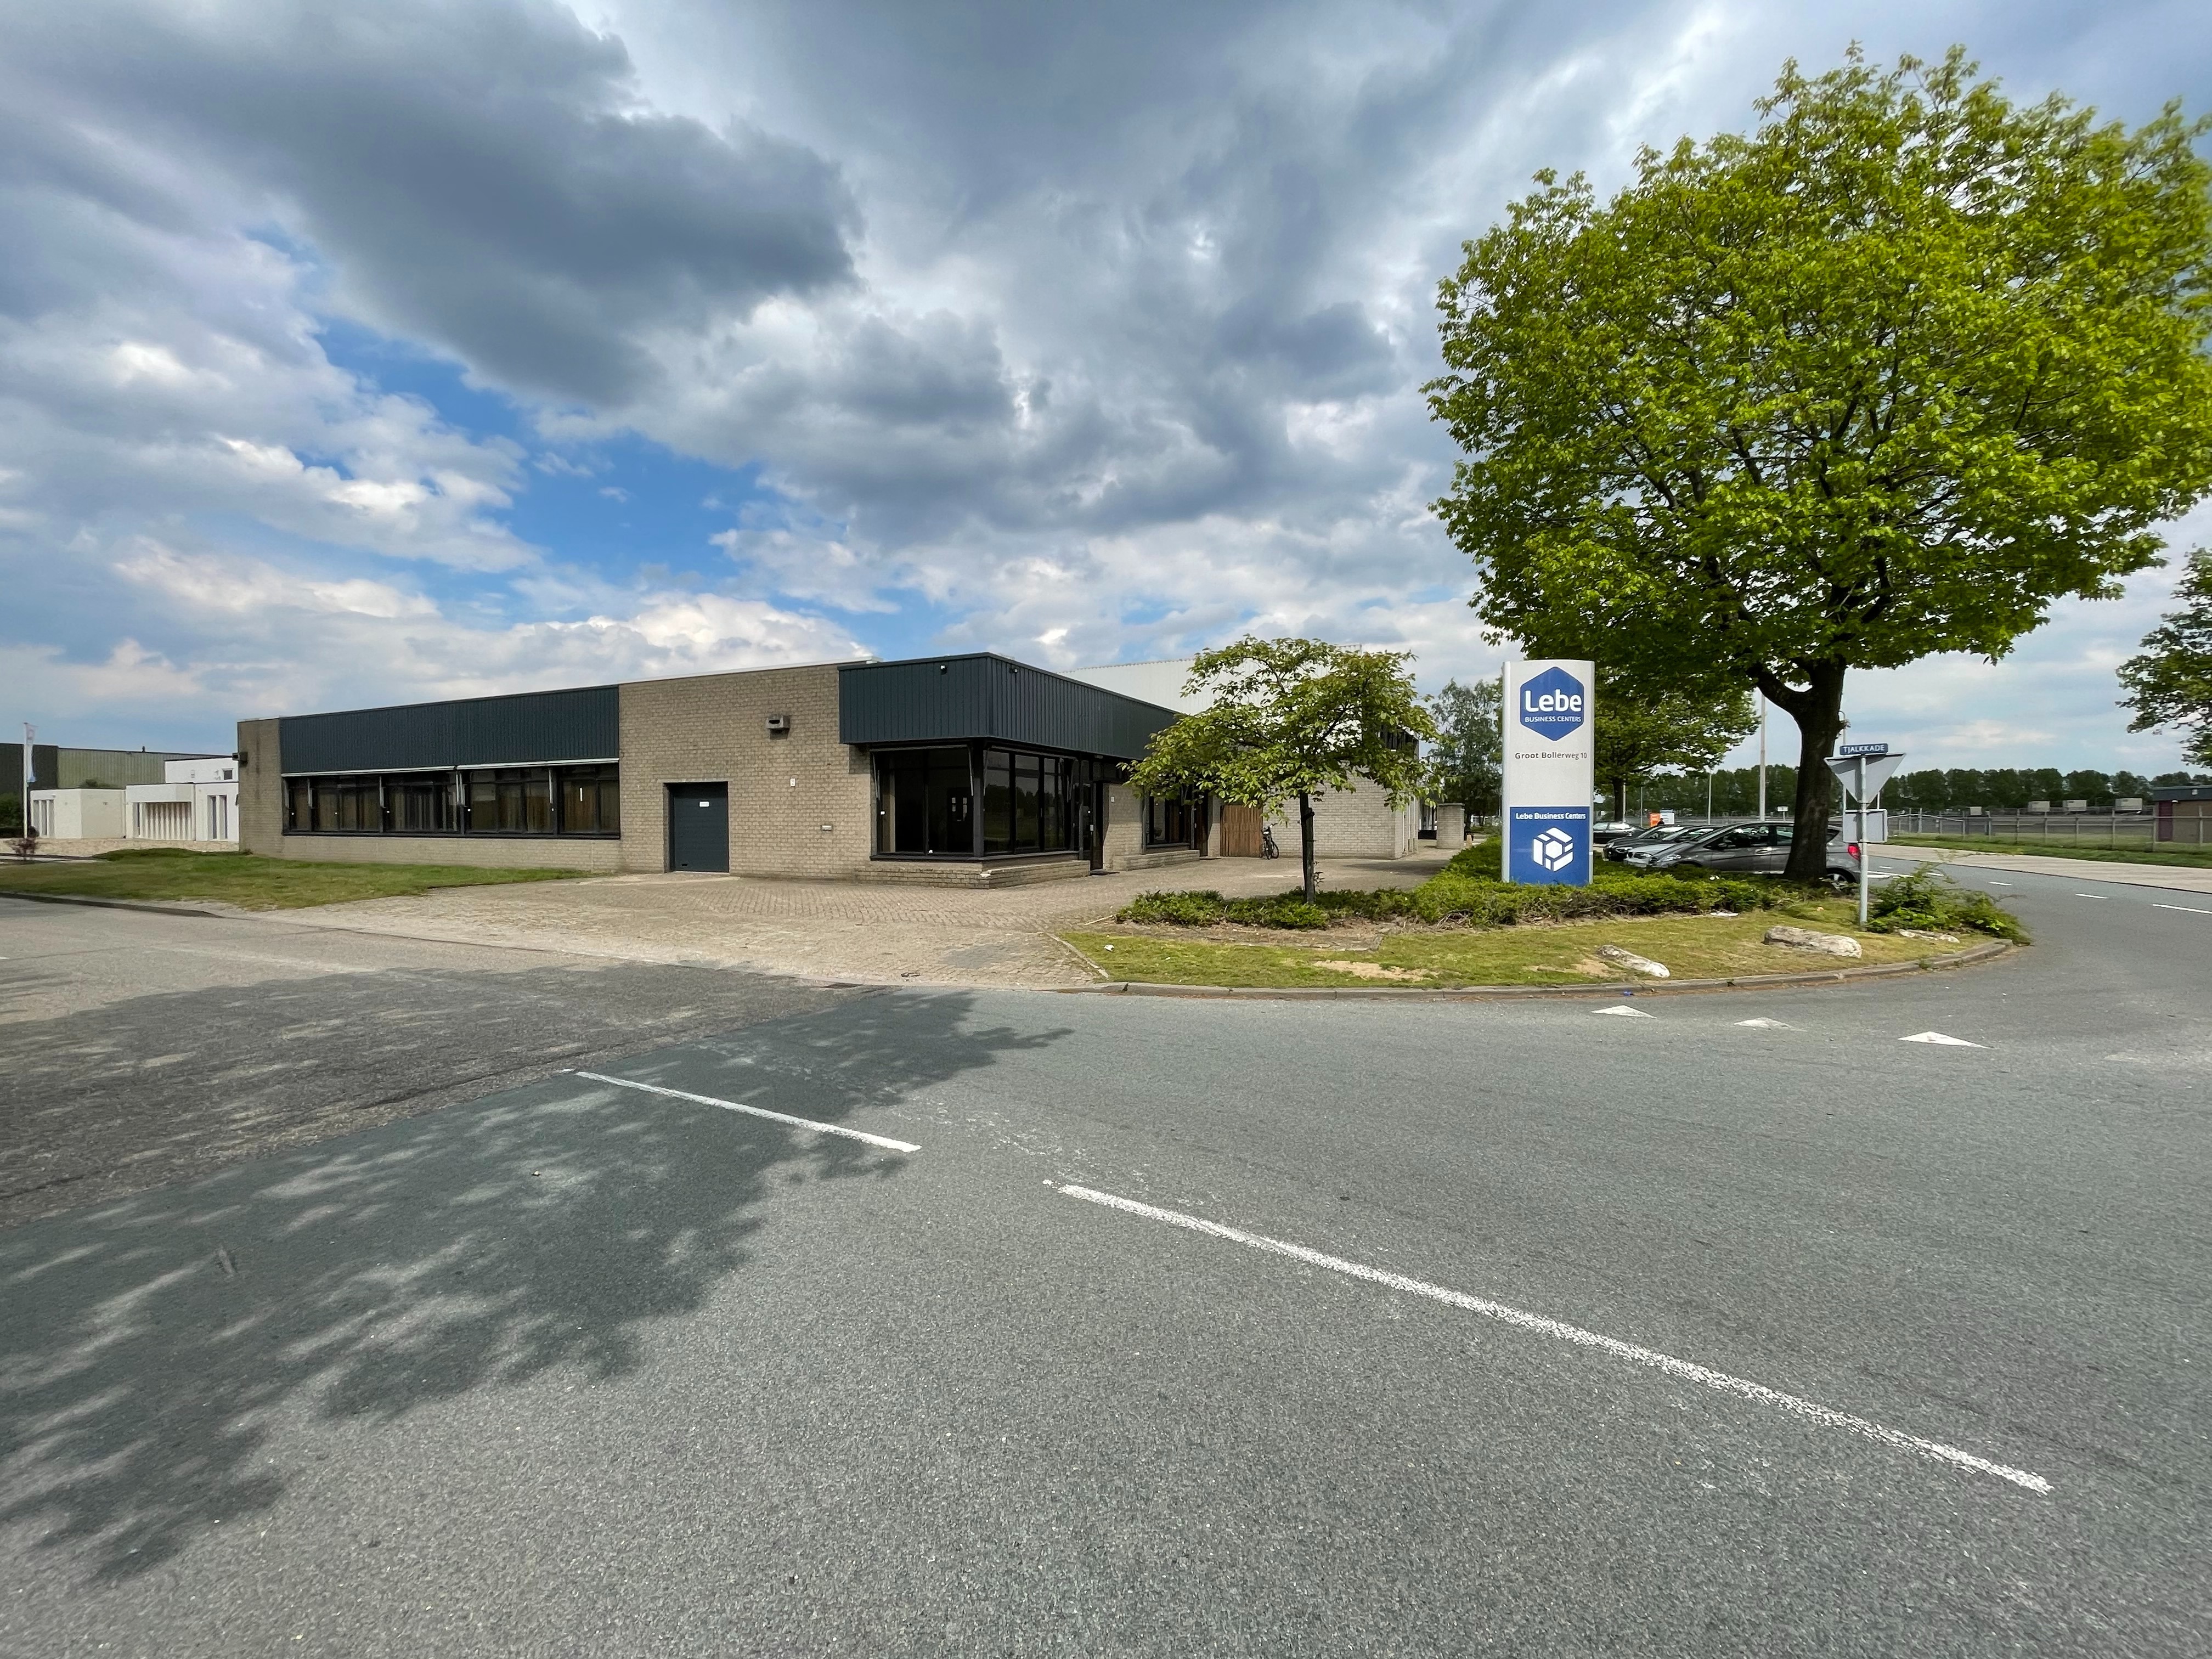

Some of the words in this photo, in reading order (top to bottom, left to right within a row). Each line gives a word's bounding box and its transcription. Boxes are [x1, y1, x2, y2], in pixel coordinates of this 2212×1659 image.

[1525, 689, 1582, 712] Lebe
[1843, 744, 1885, 754] TJALKKADE
[1542, 752, 1579, 760] Bollerweg
